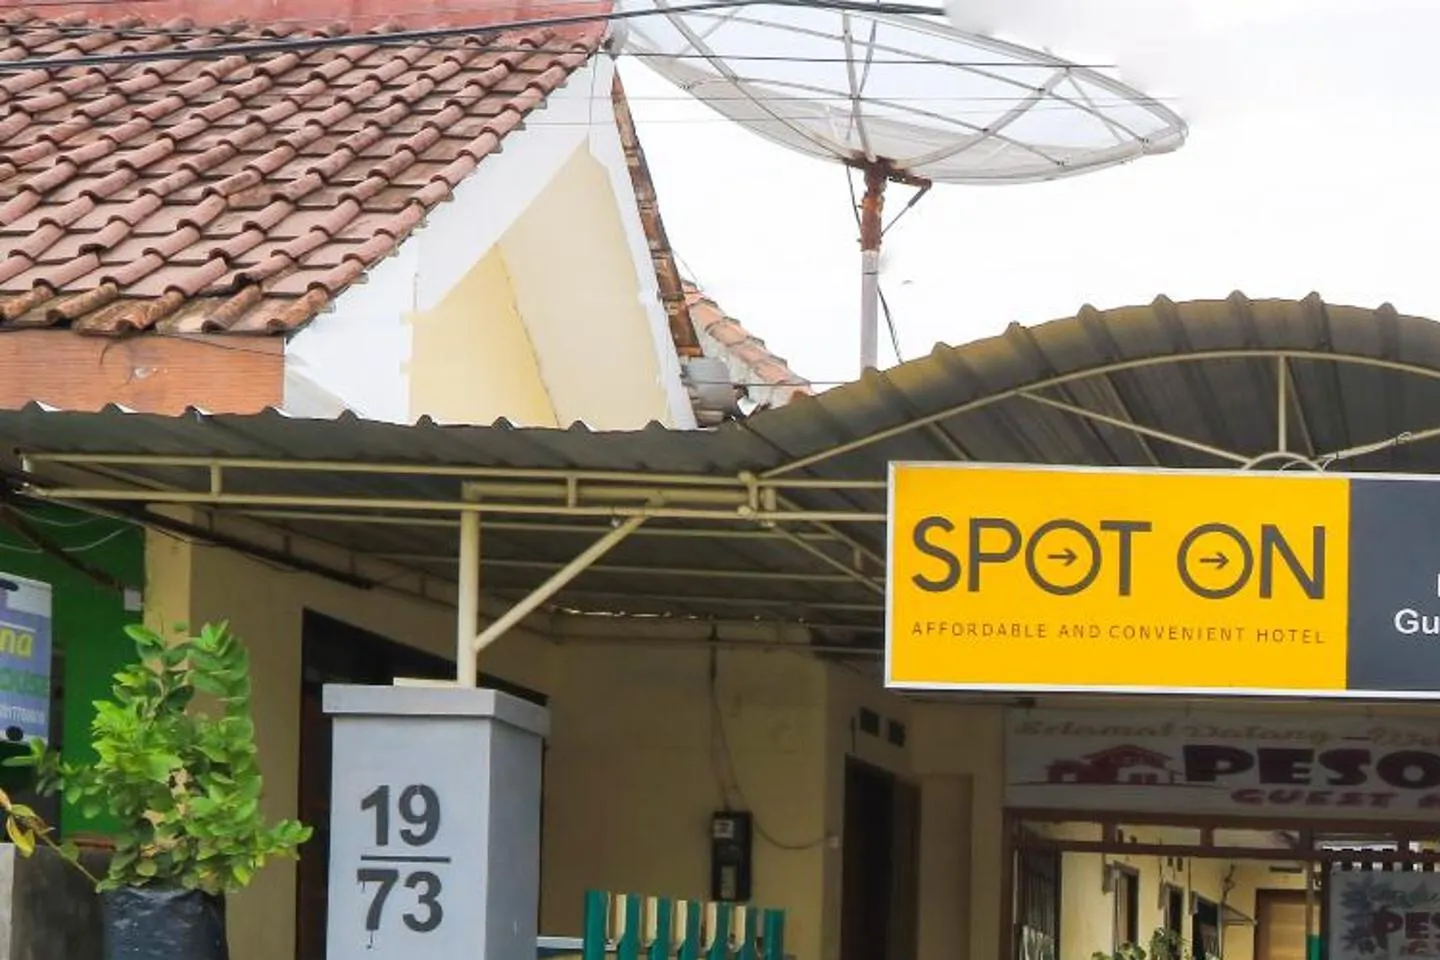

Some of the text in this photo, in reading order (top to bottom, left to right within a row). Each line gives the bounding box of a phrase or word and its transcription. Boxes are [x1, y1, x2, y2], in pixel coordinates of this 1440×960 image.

[911, 516, 1327, 600] SPOT ON
[911, 621, 1326, 645] AFFORDABLE AND CONVENIENT HOTEL
[360, 784, 441, 848] 19
[1230, 787, 1398, 807] GUEST
[357, 867, 444, 933] 73
